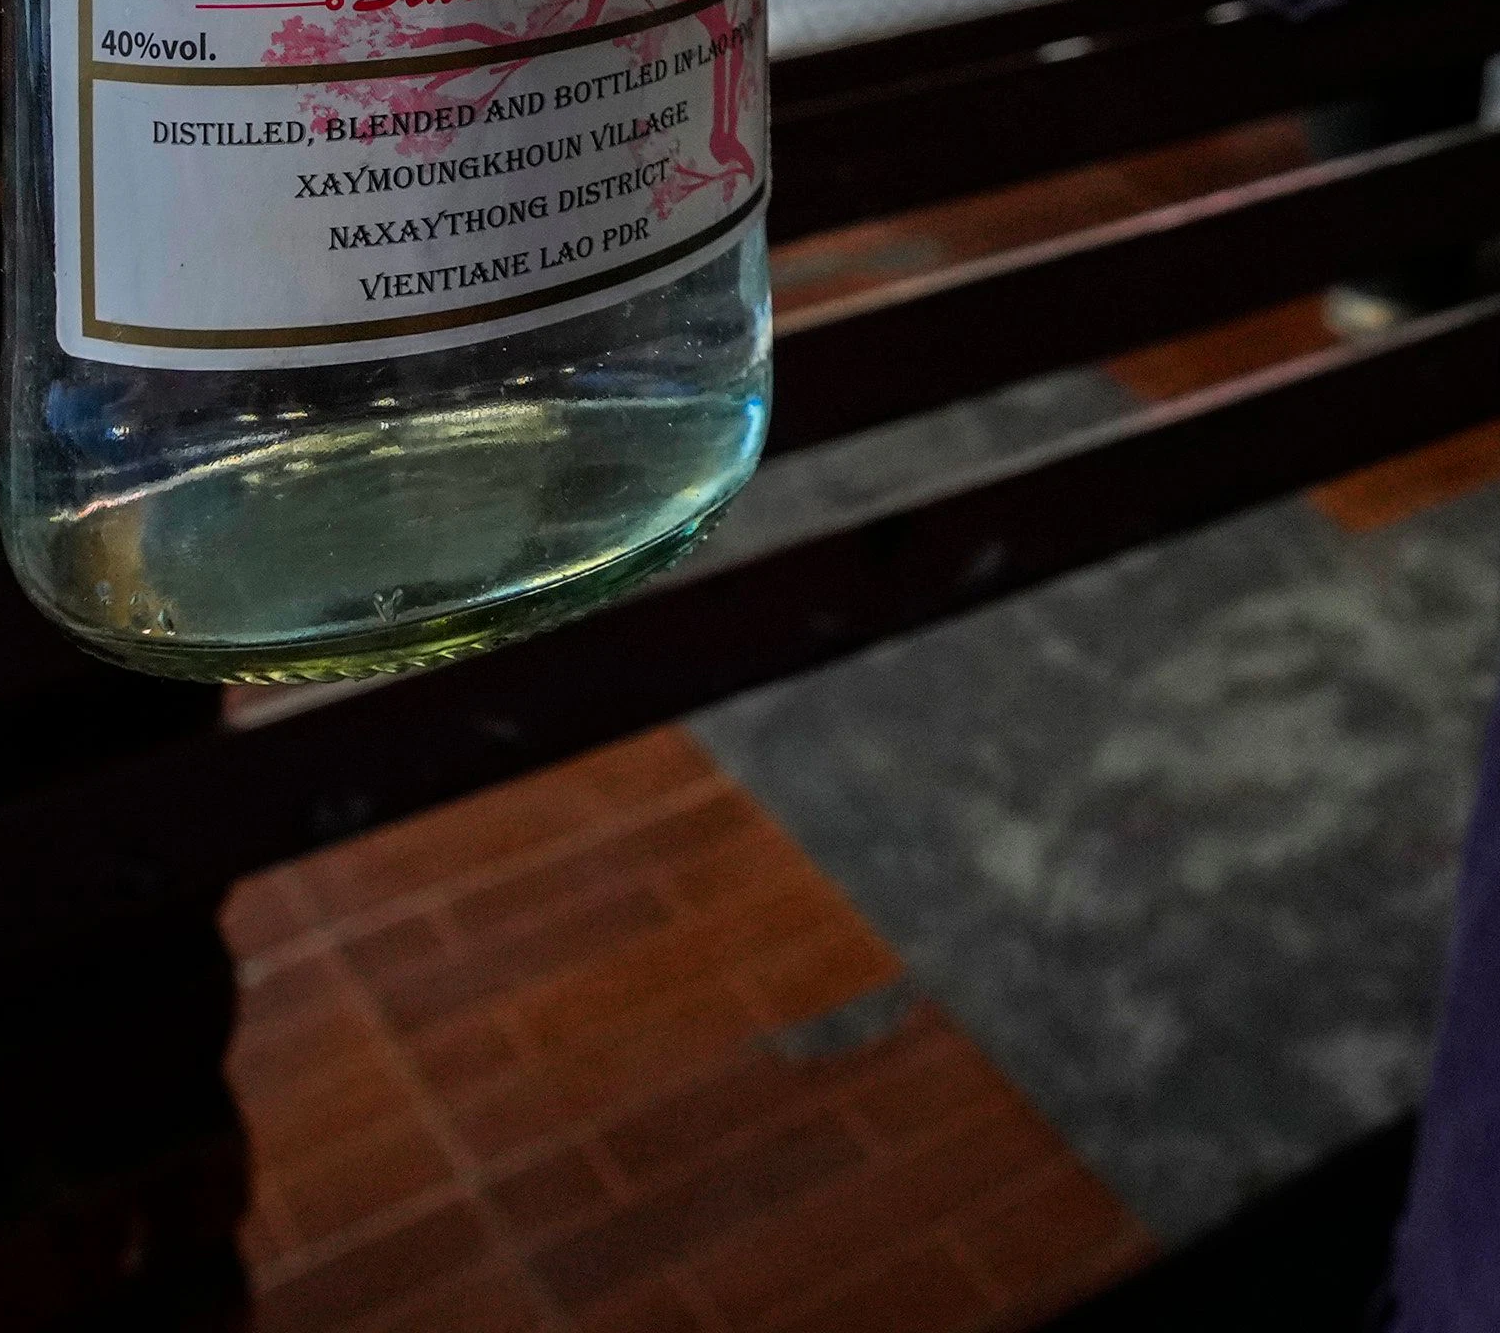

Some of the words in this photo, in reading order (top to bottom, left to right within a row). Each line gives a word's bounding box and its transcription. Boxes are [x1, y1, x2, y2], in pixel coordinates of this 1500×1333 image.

[100, 30, 217, 62] 40%vol.
[152, 119, 314, 147] DISTILLED,
[325, 104, 475, 144] BLENDED
[485, 93, 544, 123] AND
[554, 60, 668, 107] BOTTLED
[674, 51, 693, 75] IN
[295, 137, 583, 199] XAYMOUNGKHOUN
[591, 101, 689, 153] VILLAGE
[328, 196, 548, 250] NAXAYTHONG
[559, 159, 669, 213] DISTRICT
[359, 253, 529, 301] VIENTIANE
[540, 237, 594, 271] LAO
[603, 218, 648, 252] PDR
